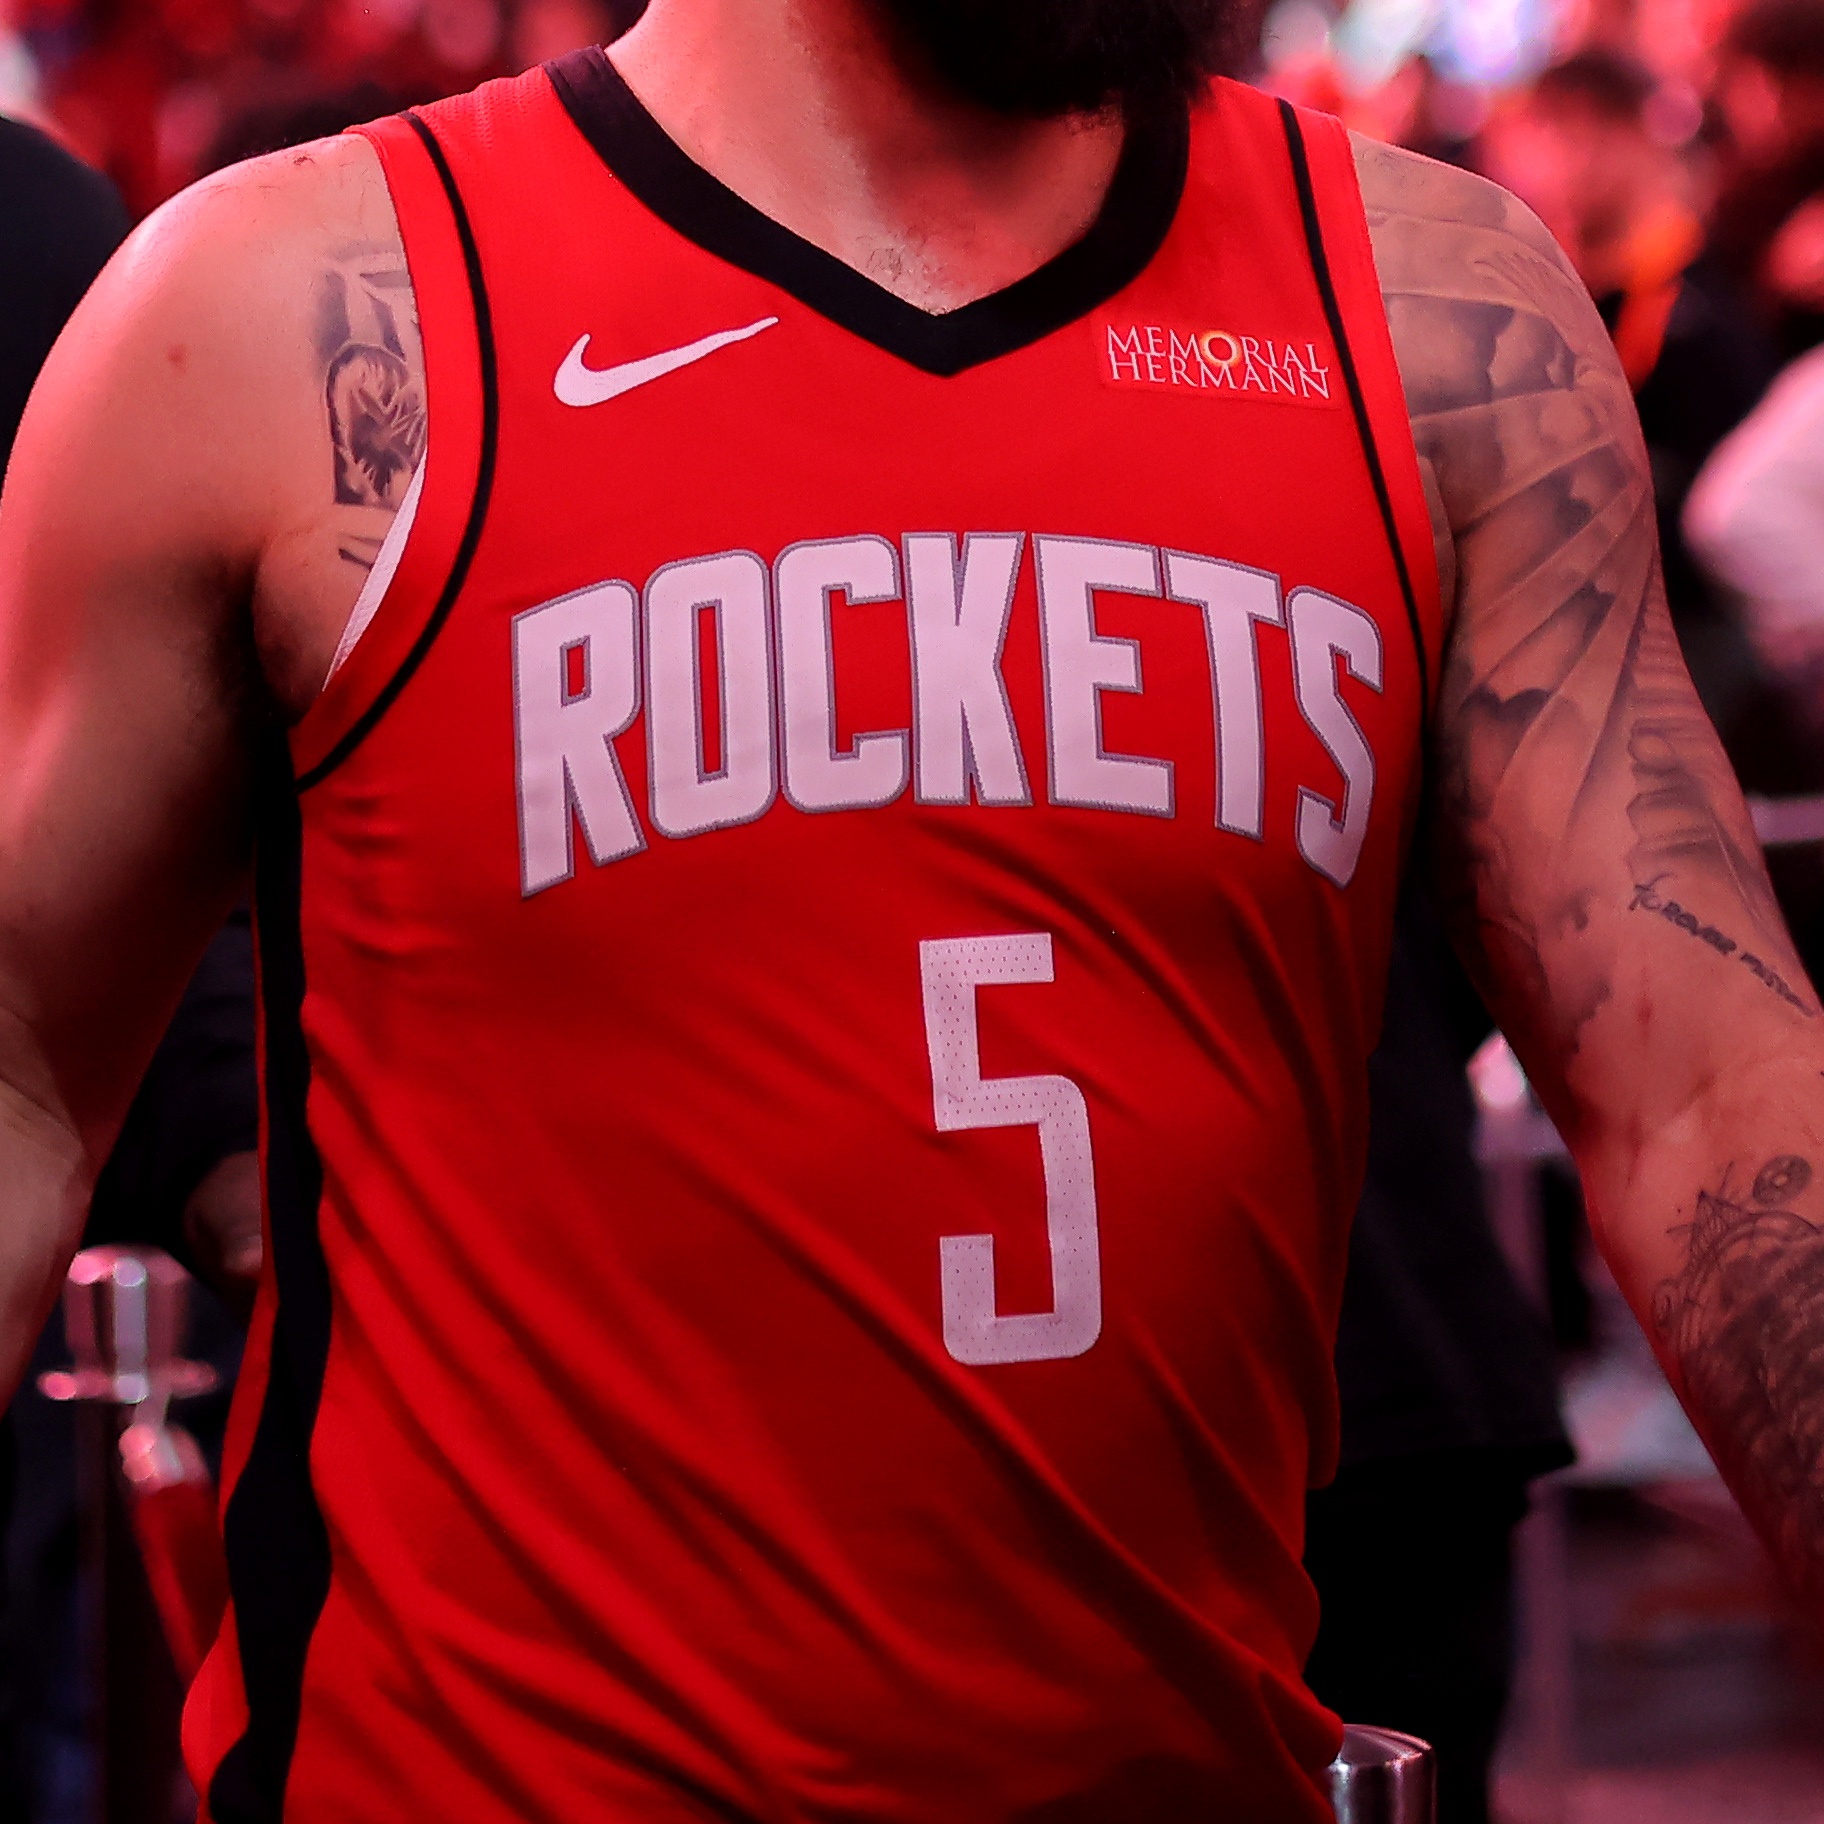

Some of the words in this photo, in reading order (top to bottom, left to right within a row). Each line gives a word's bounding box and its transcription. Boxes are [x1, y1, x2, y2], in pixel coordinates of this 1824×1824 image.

[1107, 324, 1329, 373] MEMORIAL
[1110, 350, 1330, 399] HERMANN
[511, 531, 1382, 897] ROCKETS
[919, 932, 1102, 1365] 5
